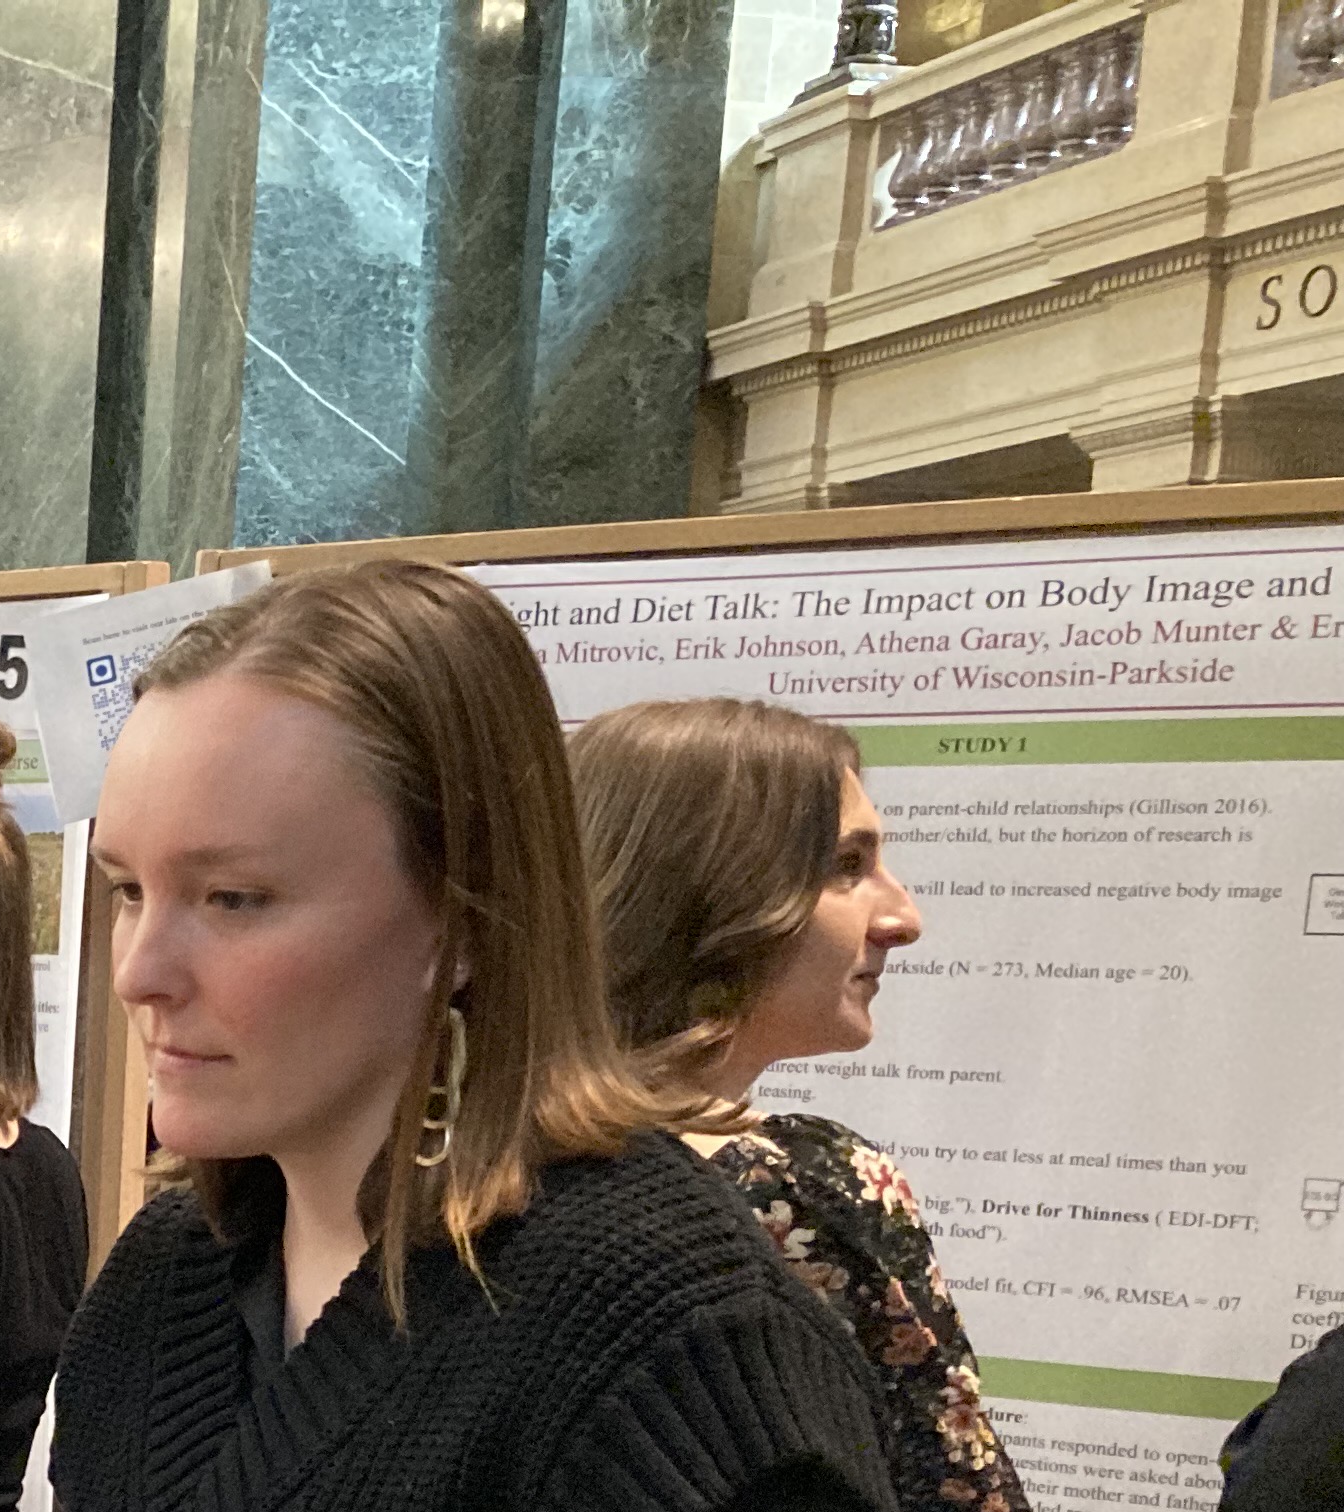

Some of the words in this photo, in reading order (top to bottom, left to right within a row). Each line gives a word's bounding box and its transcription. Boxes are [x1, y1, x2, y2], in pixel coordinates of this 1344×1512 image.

[1255, 263, 1338, 332] SO
[569, 597, 621, 626] and
[631, 597, 694, 624] Diet
[705, 592, 779, 621] Talk:
[792, 589, 851, 617] The
[862, 587, 974, 621] Impact
[985, 588, 1026, 610] on
[1040, 577, 1132, 613] Body
[1145, 575, 1255, 609] Image
[1266, 566, 1333, 598] and
[556, 639, 665, 664] Mitrovic,
[675, 636, 727, 661] Erik
[734, 635, 846, 659] Johnson,
[854, 630, 950, 655] Athena
[960, 627, 1050, 656] Garay,
[1059, 621, 1142, 648] Jacob
[1152, 619, 1263, 645] Munter
[1270, 615, 1298, 641] &
[769, 669, 905, 699] University
[913, 665, 947, 691] of
[951, 658, 1235, 690] Wisconsin-Parkside
[937, 737, 1009, 754] STUDY
[1018, 737, 1029, 753] 1
[883, 805, 904, 817] on
[908, 800, 1009, 820] parent-child
[1013, 800, 1124, 819] relationships
[1128, 799, 1208, 817] (Gillison
[998, 827, 1026, 844] but
[1031, 827, 1057, 842] the
[1062, 827, 1128, 842] horizon
[1133, 825, 1156, 842] of
[1157, 827, 1232, 842] research
[1238, 830, 1254, 843] is
[913, 880, 945, 896] will
[950, 880, 985, 897] lead
[989, 884, 1006, 896] to
[1011, 882, 1092, 898] increased
[1096, 885, 1171, 902] negative
[1176, 882, 1222, 902] body
[1227, 887, 1283, 903] image
[886, 962, 945, 977] arkside
[948, 961, 971, 978] (N
[992, 961, 1029, 979] 273,
[1034, 962, 1100, 979] Median
[1104, 967, 1137, 984] age
[814, 1061, 867, 1081] weight
[871, 1063, 900, 1079] talk
[906, 1064, 945, 1080] from
[757, 1085, 816, 1103] teasing.
[899, 1146, 930, 1160] you
[934, 1145, 958, 1163] try
[962, 1147, 979, 1161] to
[982, 1150, 1008, 1163] eat
[1012, 1148, 1044, 1164] less
[1048, 1153, 1064, 1166] at
[1069, 1153, 1111, 1169] meal
[1116, 1156, 1164, 1172] times
[1169, 1156, 1207, 1174] than
[1211, 1163, 1247, 1179] you
[982, 1199, 1032, 1218] Drive
[1035, 1202, 1064, 1218] for
[1067, 1203, 1151, 1224] Thinness
[995, 1278, 1017, 1296] fit,
[1022, 1280, 1056, 1298] CFI
[1115, 1287, 1189, 1308] RMSEA
[1050, 1440, 1138, 1459] responded
[1143, 1448, 1161, 1461] to
[1082, 1465, 1125, 1481] were
[1128, 1468, 1179, 1486] asked
[1063, 1486, 1125, 1503] mother
[1128, 1492, 1161, 1507] and
